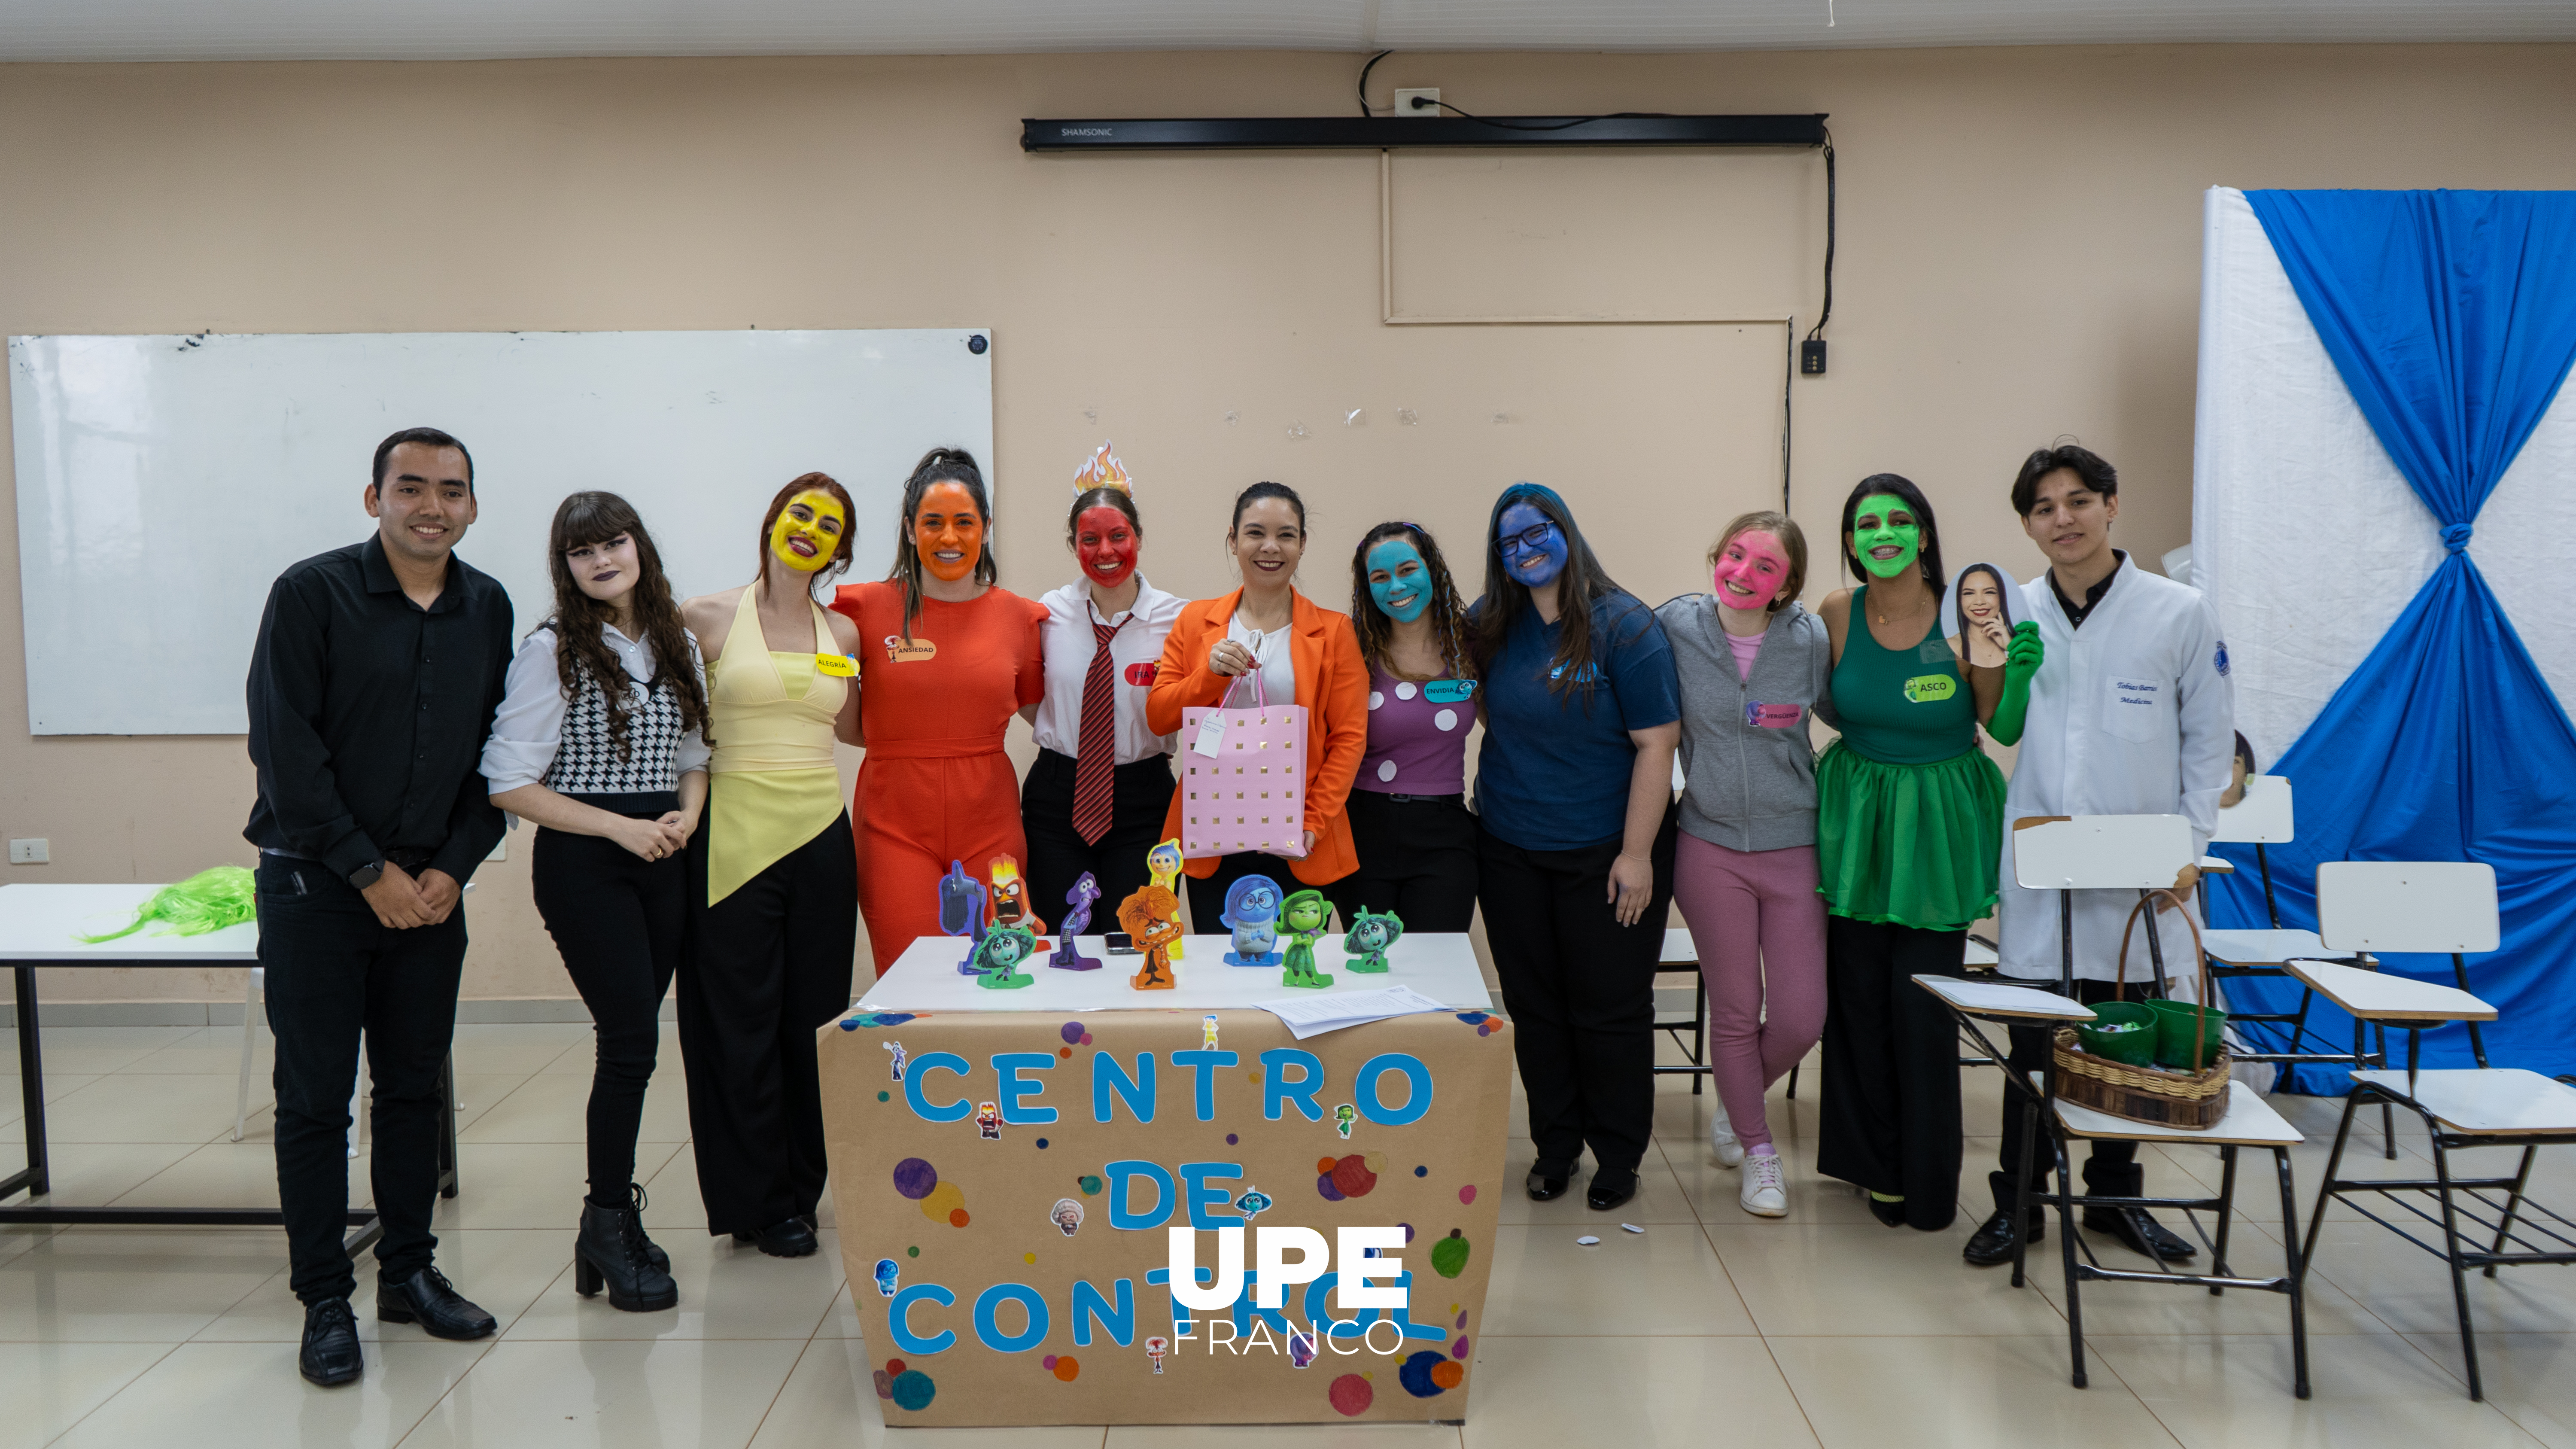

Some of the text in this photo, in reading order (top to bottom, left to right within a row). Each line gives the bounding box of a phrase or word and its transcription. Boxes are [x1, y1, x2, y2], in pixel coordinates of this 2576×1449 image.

[1061, 128, 1112, 136] SHAMSONIC
[818, 659, 847, 668] ALEGRÍA
[1920, 682, 1946, 692] ASCO
[903, 1048, 1433, 1126] CENTRO
[1104, 1160, 1245, 1231] DE
